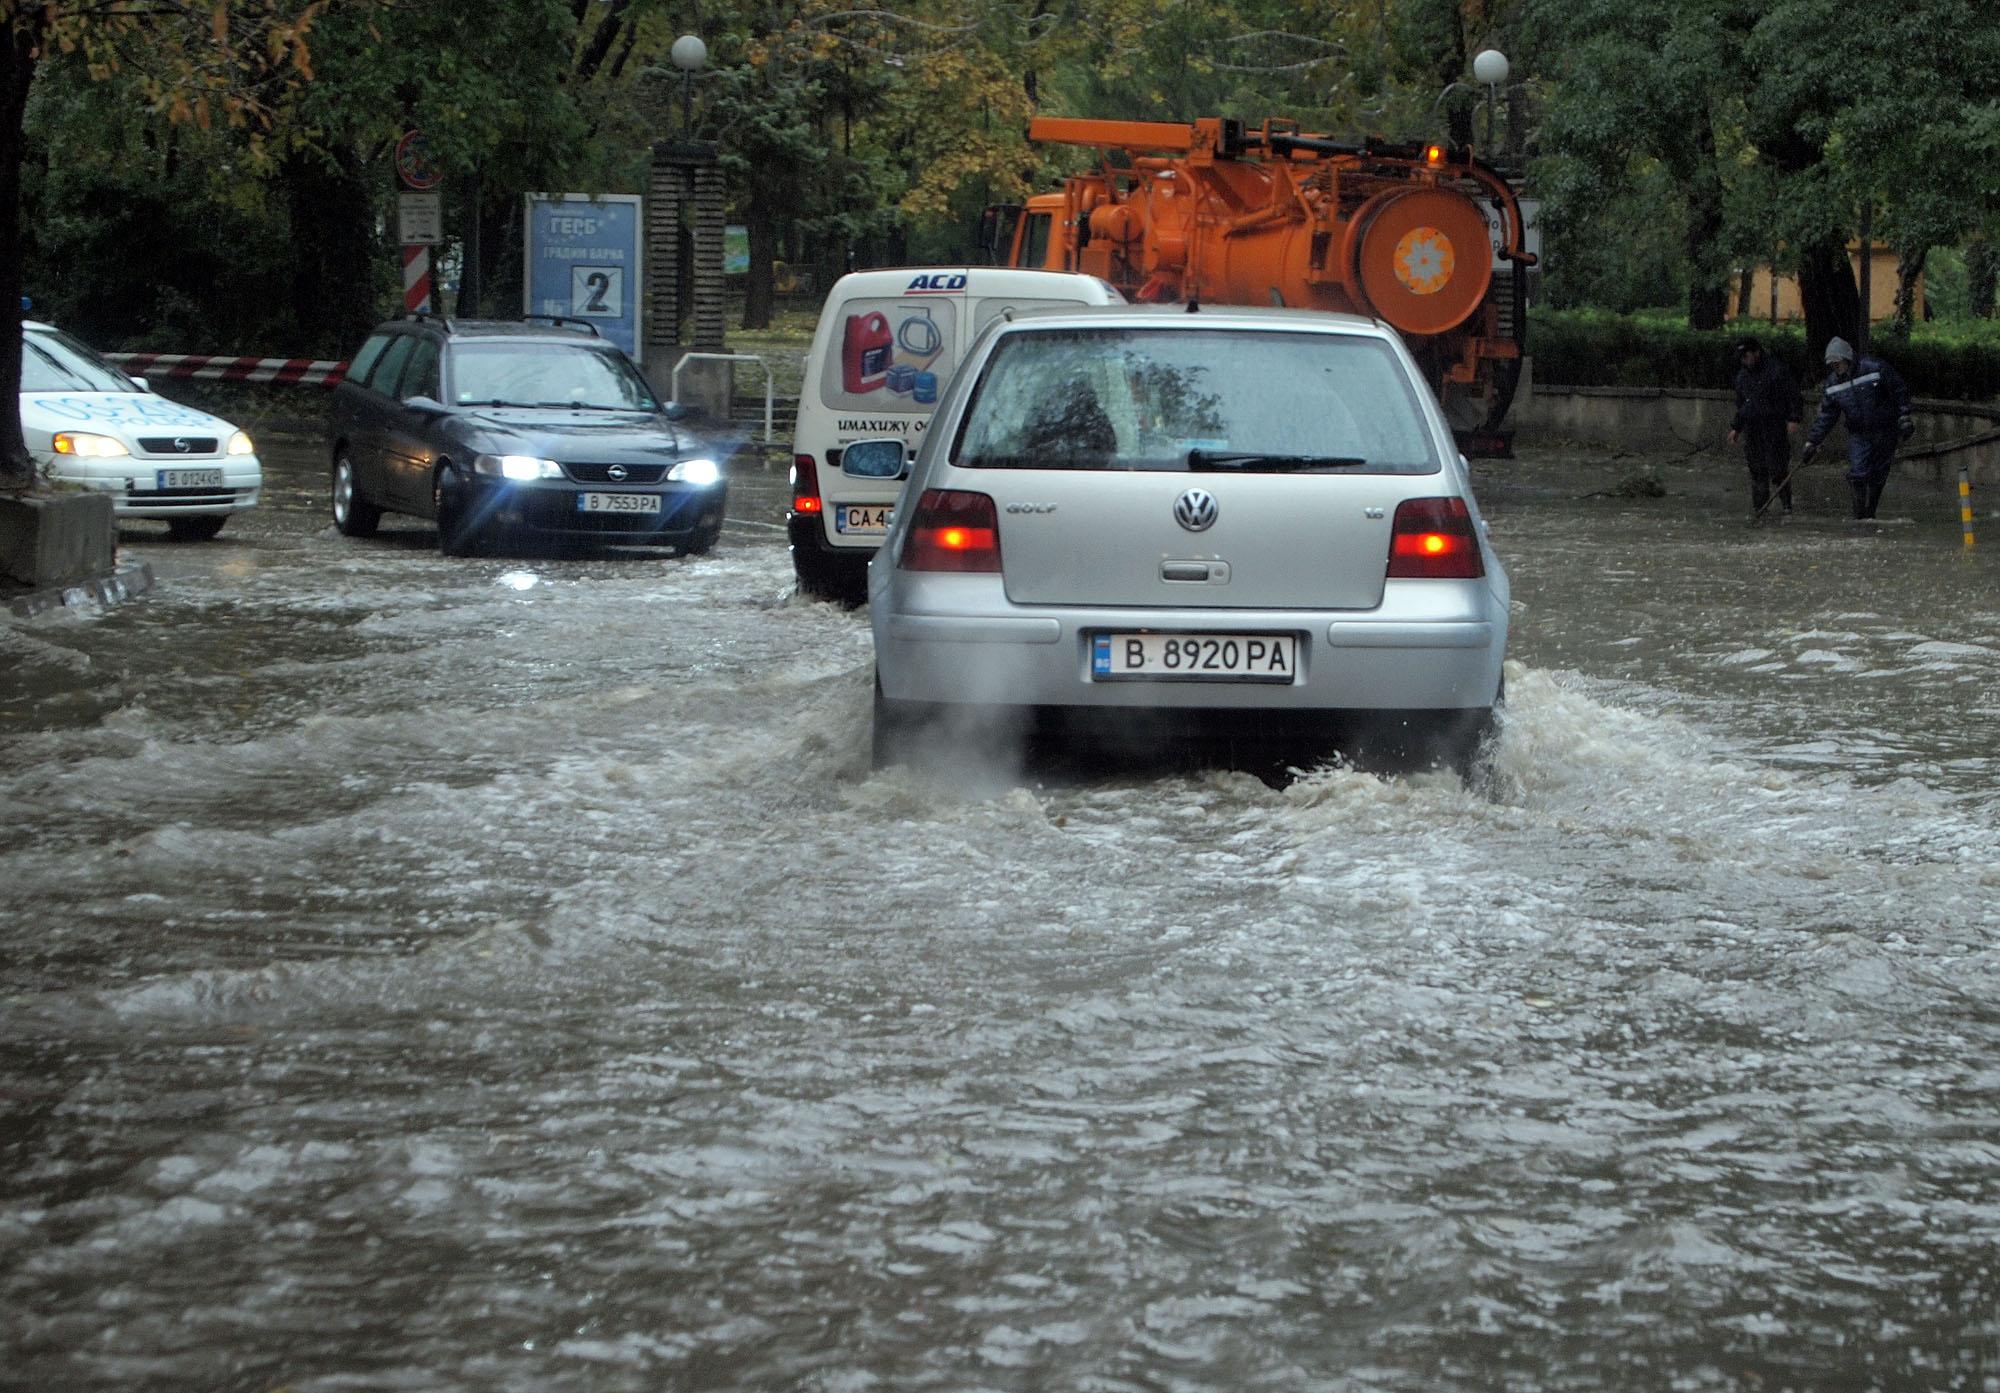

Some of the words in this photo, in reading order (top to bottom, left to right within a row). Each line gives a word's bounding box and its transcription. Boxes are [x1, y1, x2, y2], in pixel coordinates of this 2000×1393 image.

[907, 274, 966, 289] ACD
[586, 272, 609, 312] 2
[606, 495, 639, 510] 7553
[1006, 502, 1058, 514] GOLF
[1163, 639, 1239, 669] 8920
